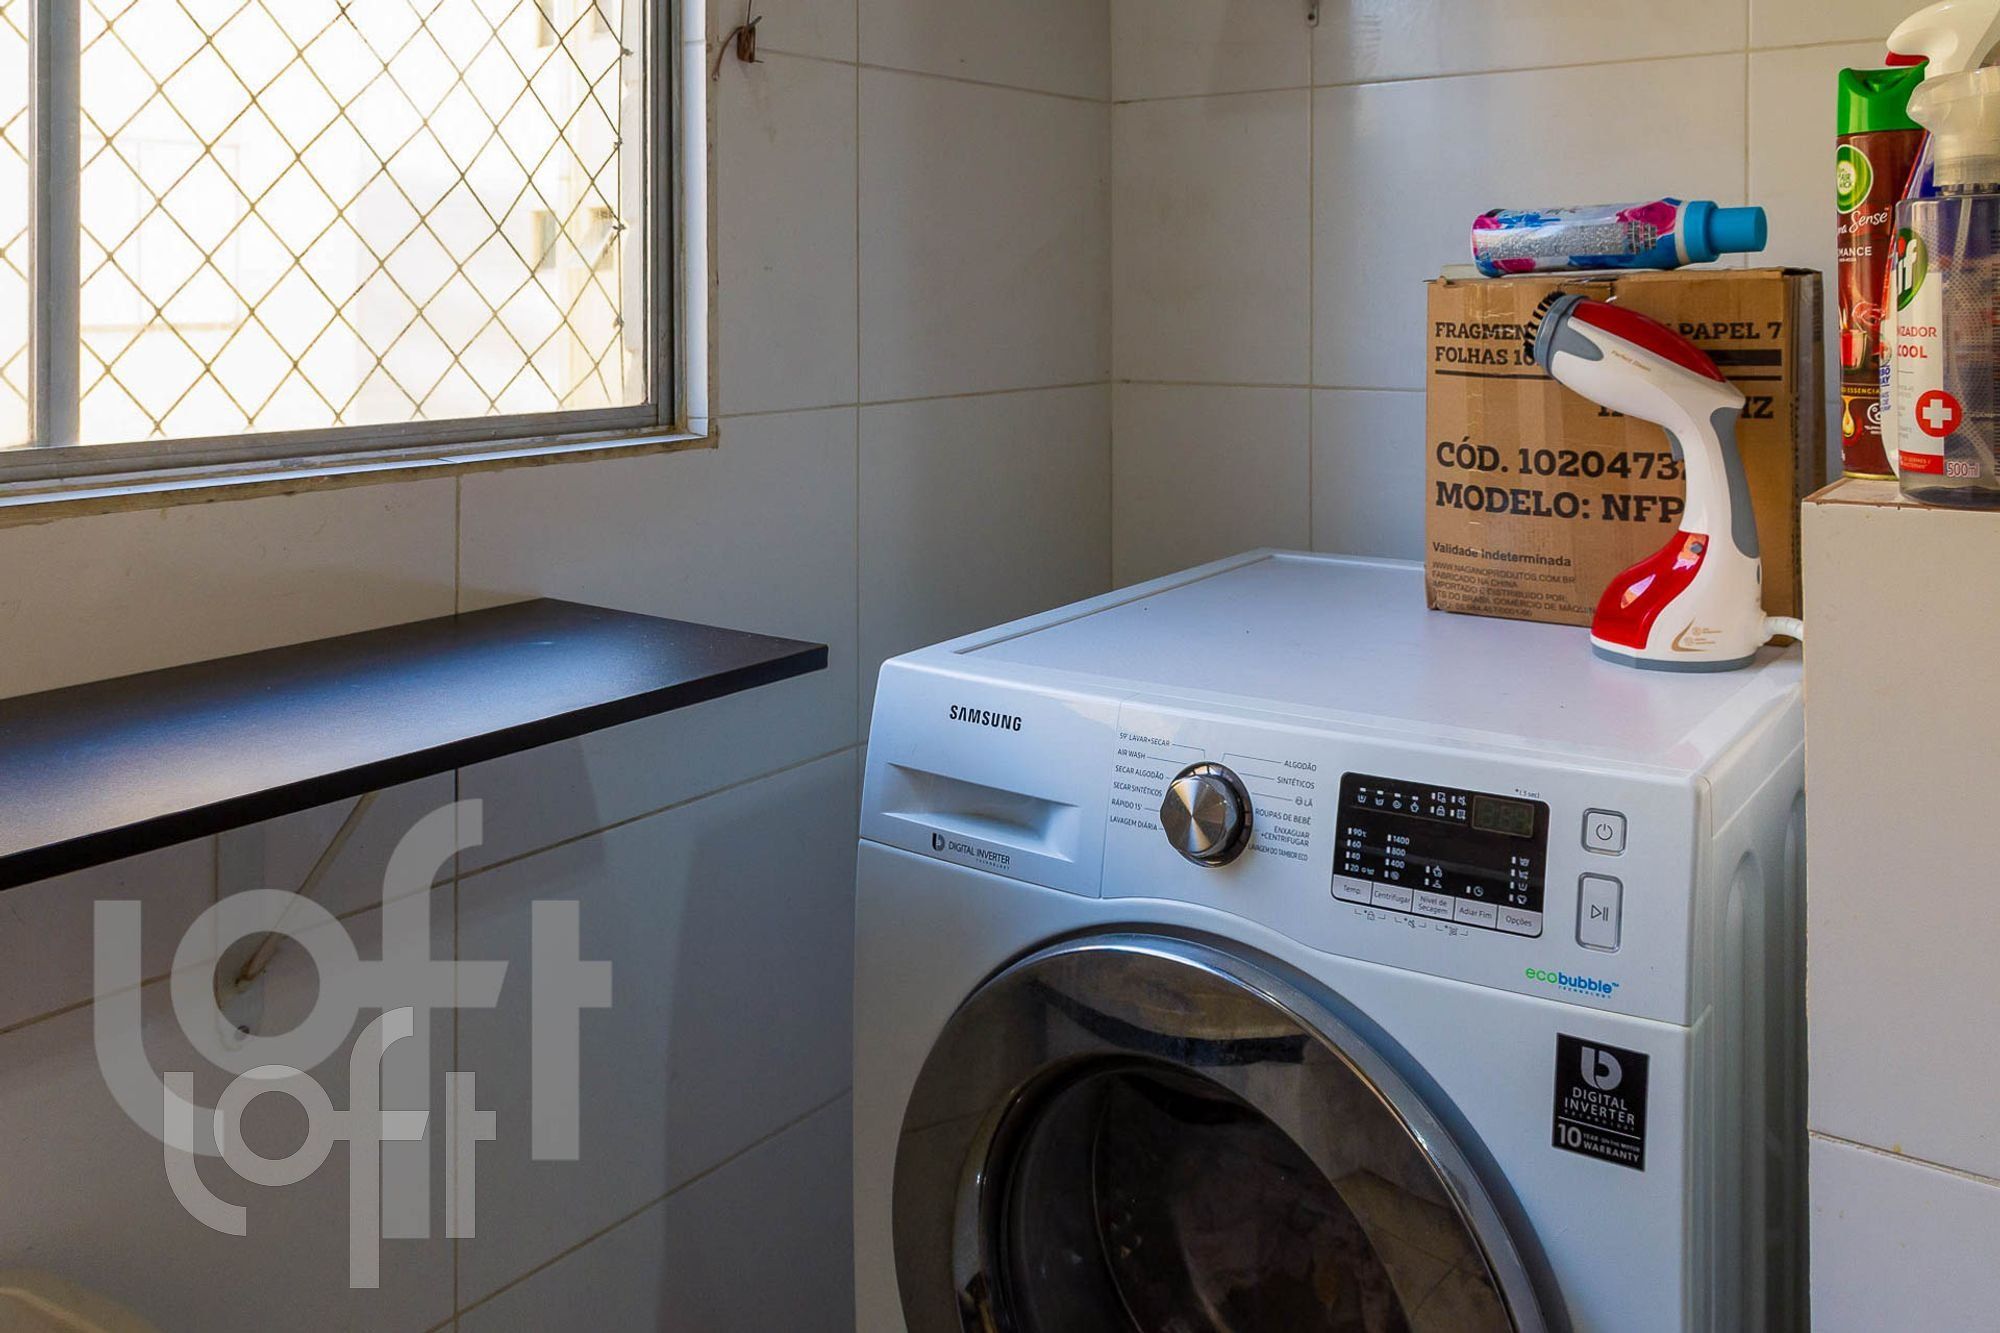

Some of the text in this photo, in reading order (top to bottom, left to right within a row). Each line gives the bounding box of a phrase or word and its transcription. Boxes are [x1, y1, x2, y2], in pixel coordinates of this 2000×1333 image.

[1838, 246, 1872, 257] MANCE
[1897, 236, 1918, 295] if
[1435, 321, 1782, 340] FRAGMEN PAPEL 7
[1897, 326, 1937, 337] IZADOR
[1435, 346, 1508, 366] FOLHAS
[1436, 436, 1686, 480] CÓD. 1020473
[1436, 481, 1590, 520] MODELO:
[1433, 541, 1479, 559] Validade
[950, 705, 1022, 731] SAMSUNG
[1118, 748, 1146, 759] AIR WASH
[1115, 764, 1134, 774] SECAR
[1284, 760, 1317, 772] ALGODÃO
[1113, 781, 1131, 790] SECAR
[1110, 815, 1136, 826] LAVAGEM
[1255, 808, 1282, 820] ROUPAS
[1283, 813, 1292, 822] DE
[1393, 835, 1410, 845] 1400
[948, 841, 1011, 865] DIGITAL INVERTER
[1390, 860, 1405, 869] 400
[1505, 914, 1533, 927] Opções
[1573, 1086, 1629, 1111] DIGITAL
[1565, 1097, 1635, 1126] INVERTER
[1557, 1123, 1582, 1149] 10
[1583, 1140, 1640, 1162] WARRANTY
